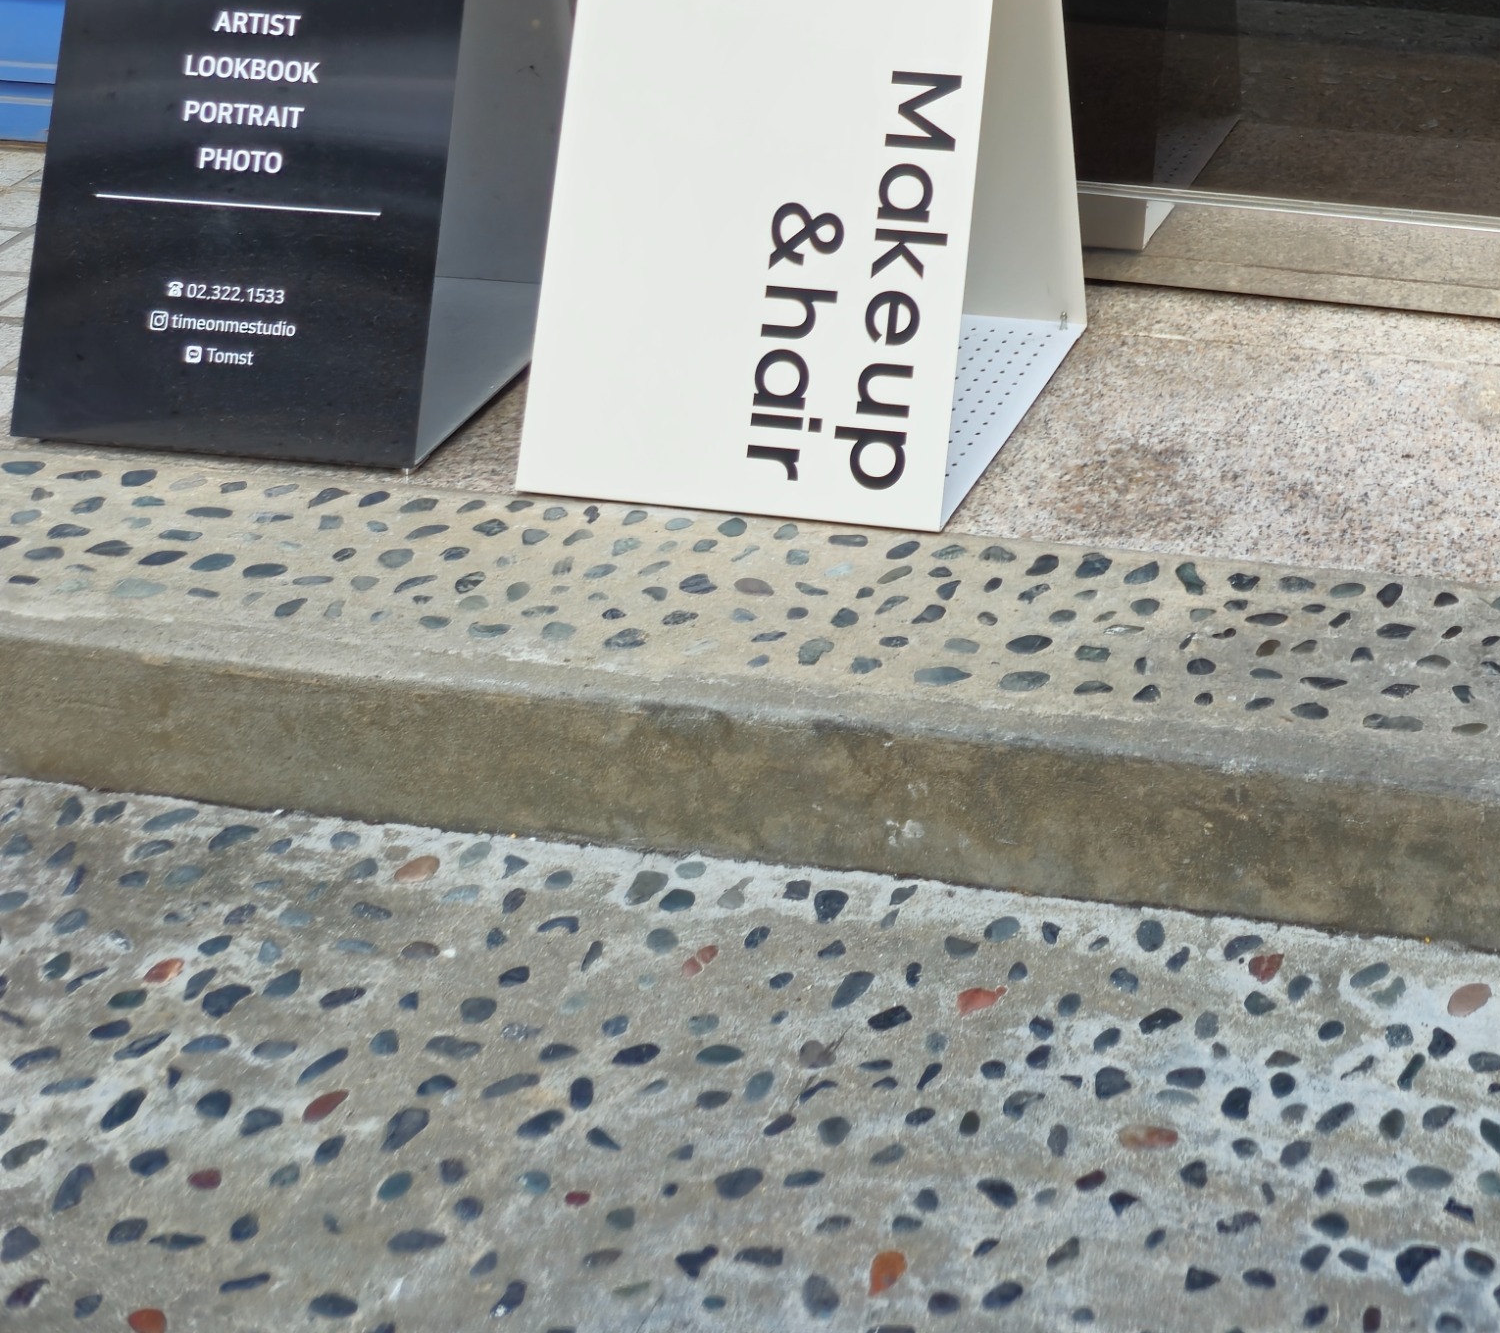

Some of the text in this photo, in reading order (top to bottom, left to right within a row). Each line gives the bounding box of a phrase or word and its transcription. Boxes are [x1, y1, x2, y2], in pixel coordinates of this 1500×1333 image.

[213, 10, 302, 37] ARTIST
[184, 54, 321, 84] LOOKBOOK
[182, 100, 305, 129] PORTRAIT
[198, 147, 284, 174] PHOTO
[186, 283, 286, 305] 02.322.1533
[834, 70, 963, 491] Makeup
[171, 313, 296, 337] timeonmestudio
[206, 347, 255, 366] Tomst
